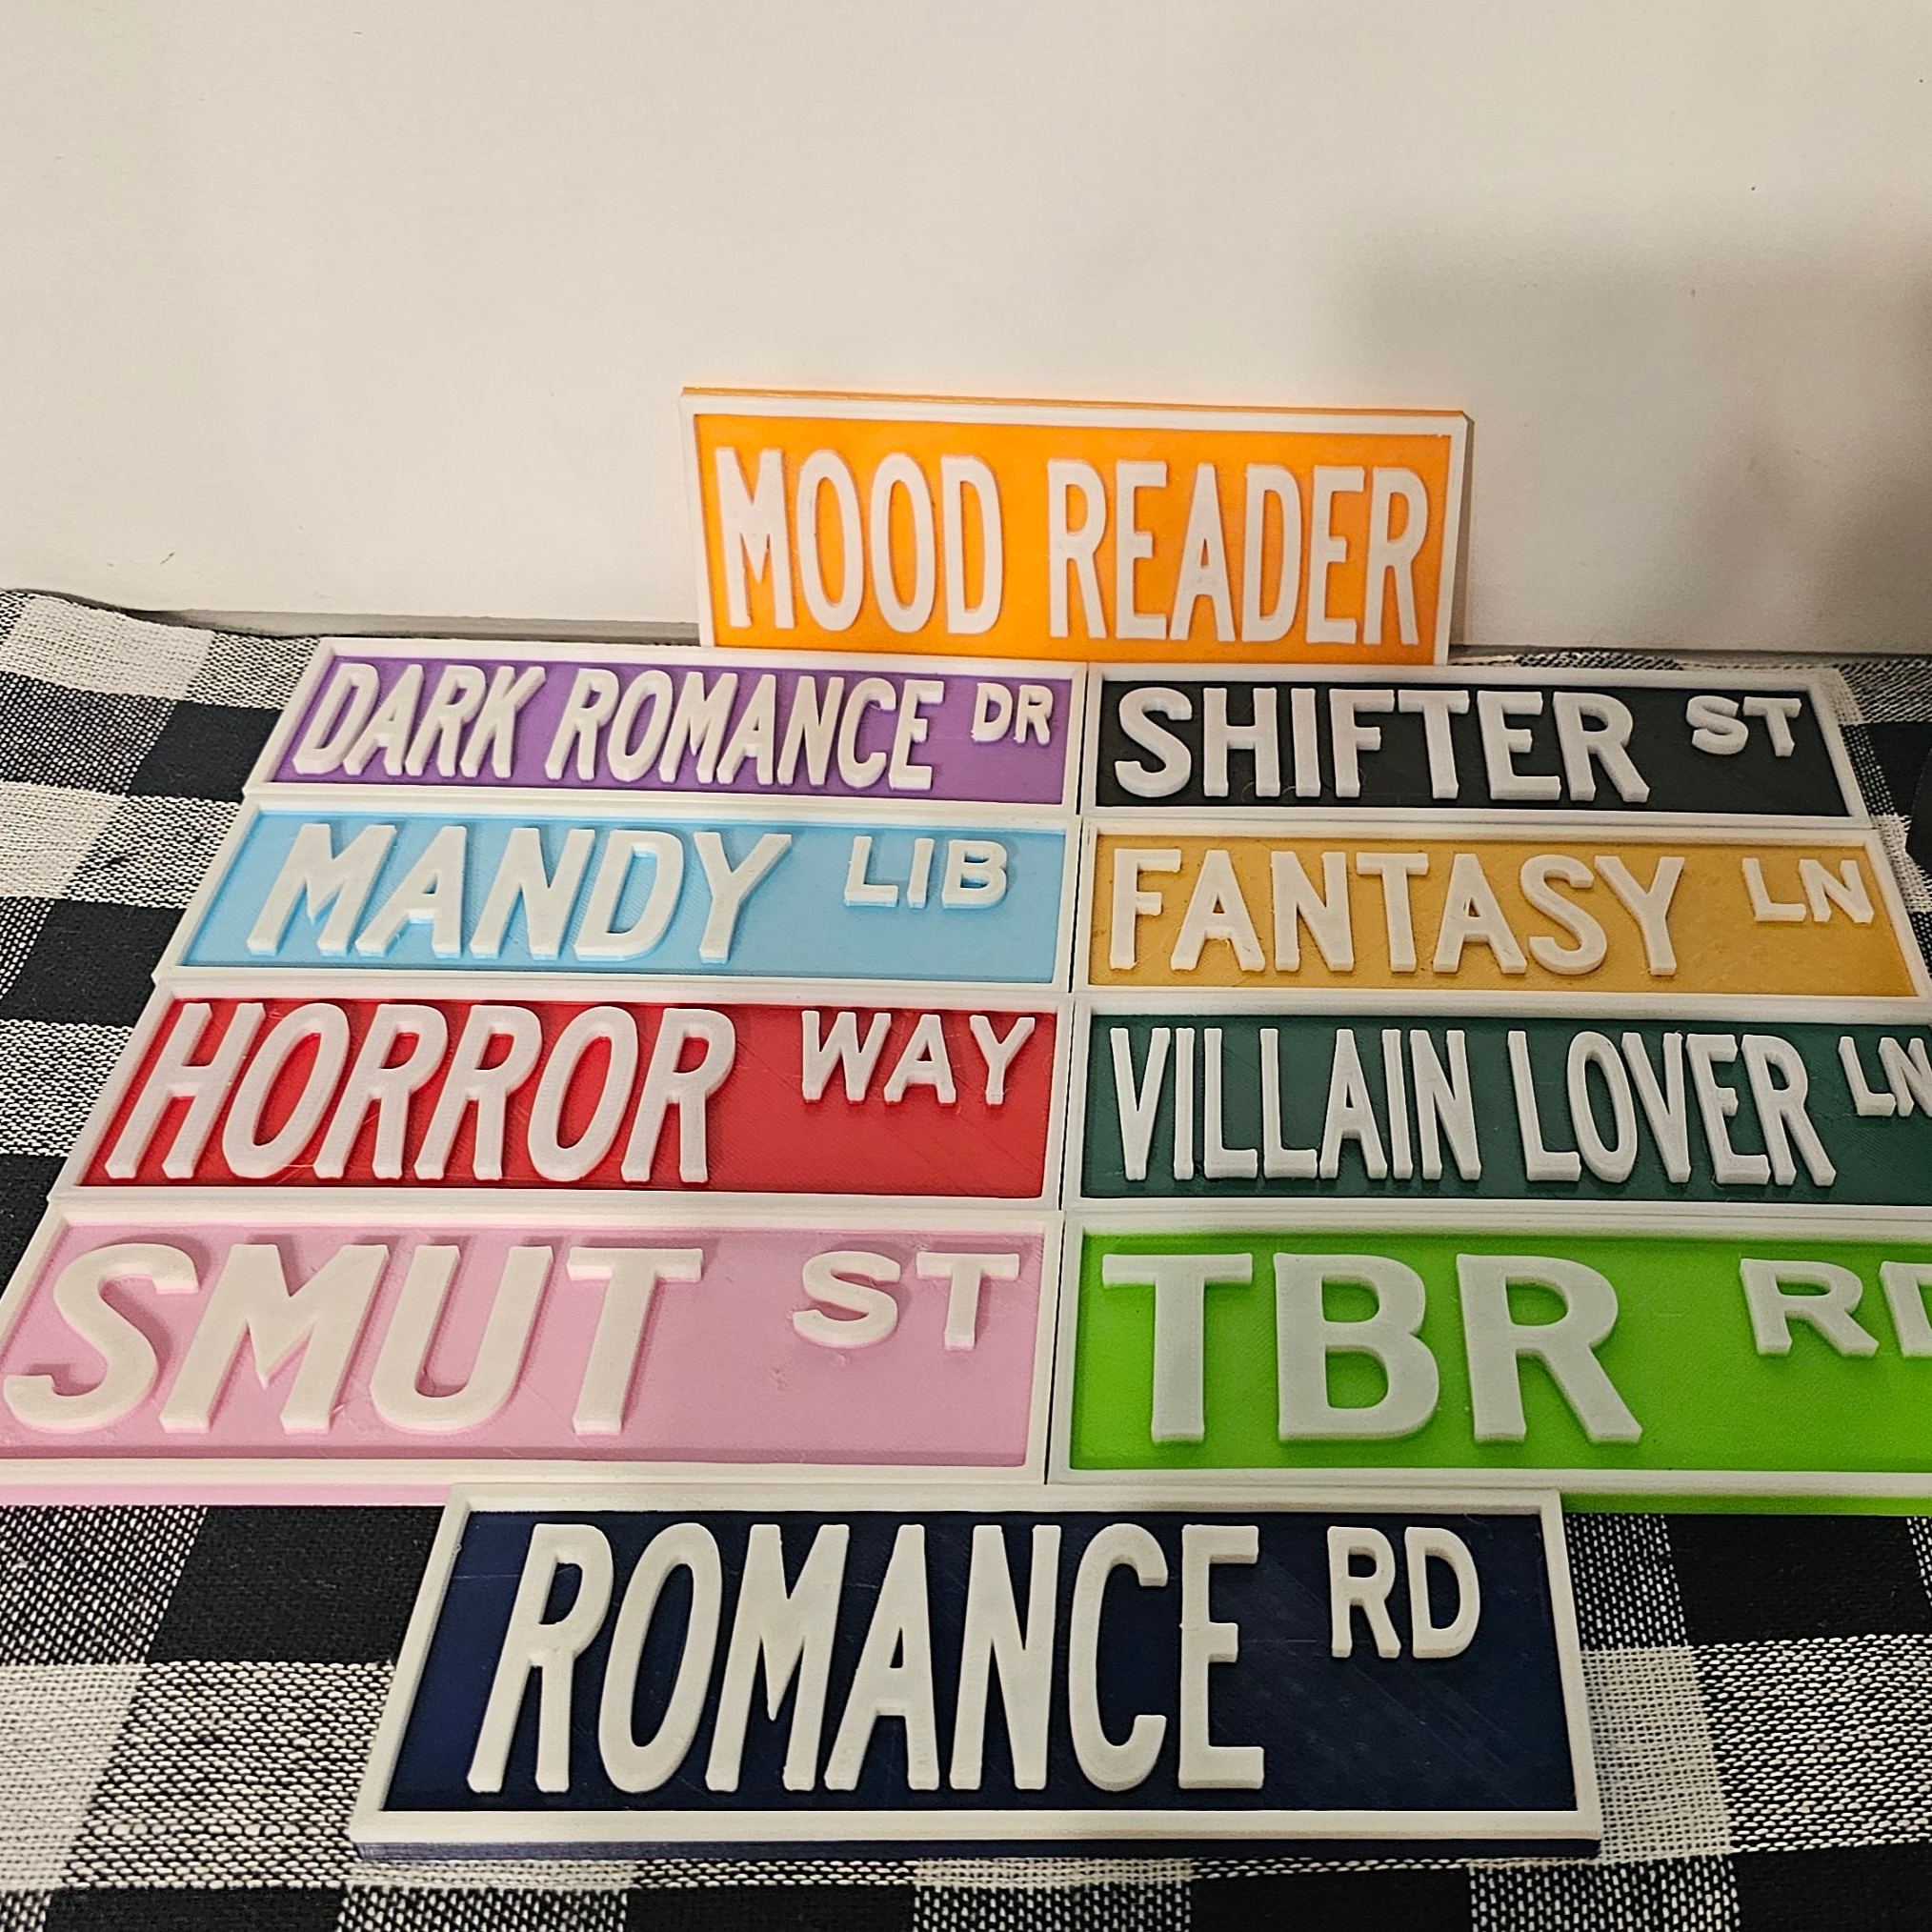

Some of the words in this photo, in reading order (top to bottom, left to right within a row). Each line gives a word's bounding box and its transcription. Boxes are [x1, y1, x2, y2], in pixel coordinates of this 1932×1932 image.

[715, 446, 1002, 634] MOOD
[1048, 459, 1428, 645] READER
[293, 663, 546, 777] DARK
[546, 668, 945, 790] ROMANCE
[972, 683, 1052, 745] DR
[1115, 687, 1650, 802] SHIFTER
[1686, 695, 1801, 756] ST
[246, 823, 792, 963] MANDY
[844, 835, 1007, 908] LIB
[1110, 848, 1684, 976] FANTASY
[1742, 858, 1874, 923] LN
[106, 1002, 735, 1182] HORROR
[802, 1010, 1034, 1105] WAY
[1110, 1027, 1481, 1180] VILLAIN
[1508, 1031, 1836, 1186] LOVER
[1839, 1036, 1932, 1118] LN
[3, 1242, 703, 1435] SMUT
[792, 1251, 1019, 1349] ST
[1102, 1253, 1642, 1443] TBR
[468, 1523, 1263, 1793] ROMANCE
[1328, 1526, 1480, 1659] RD
